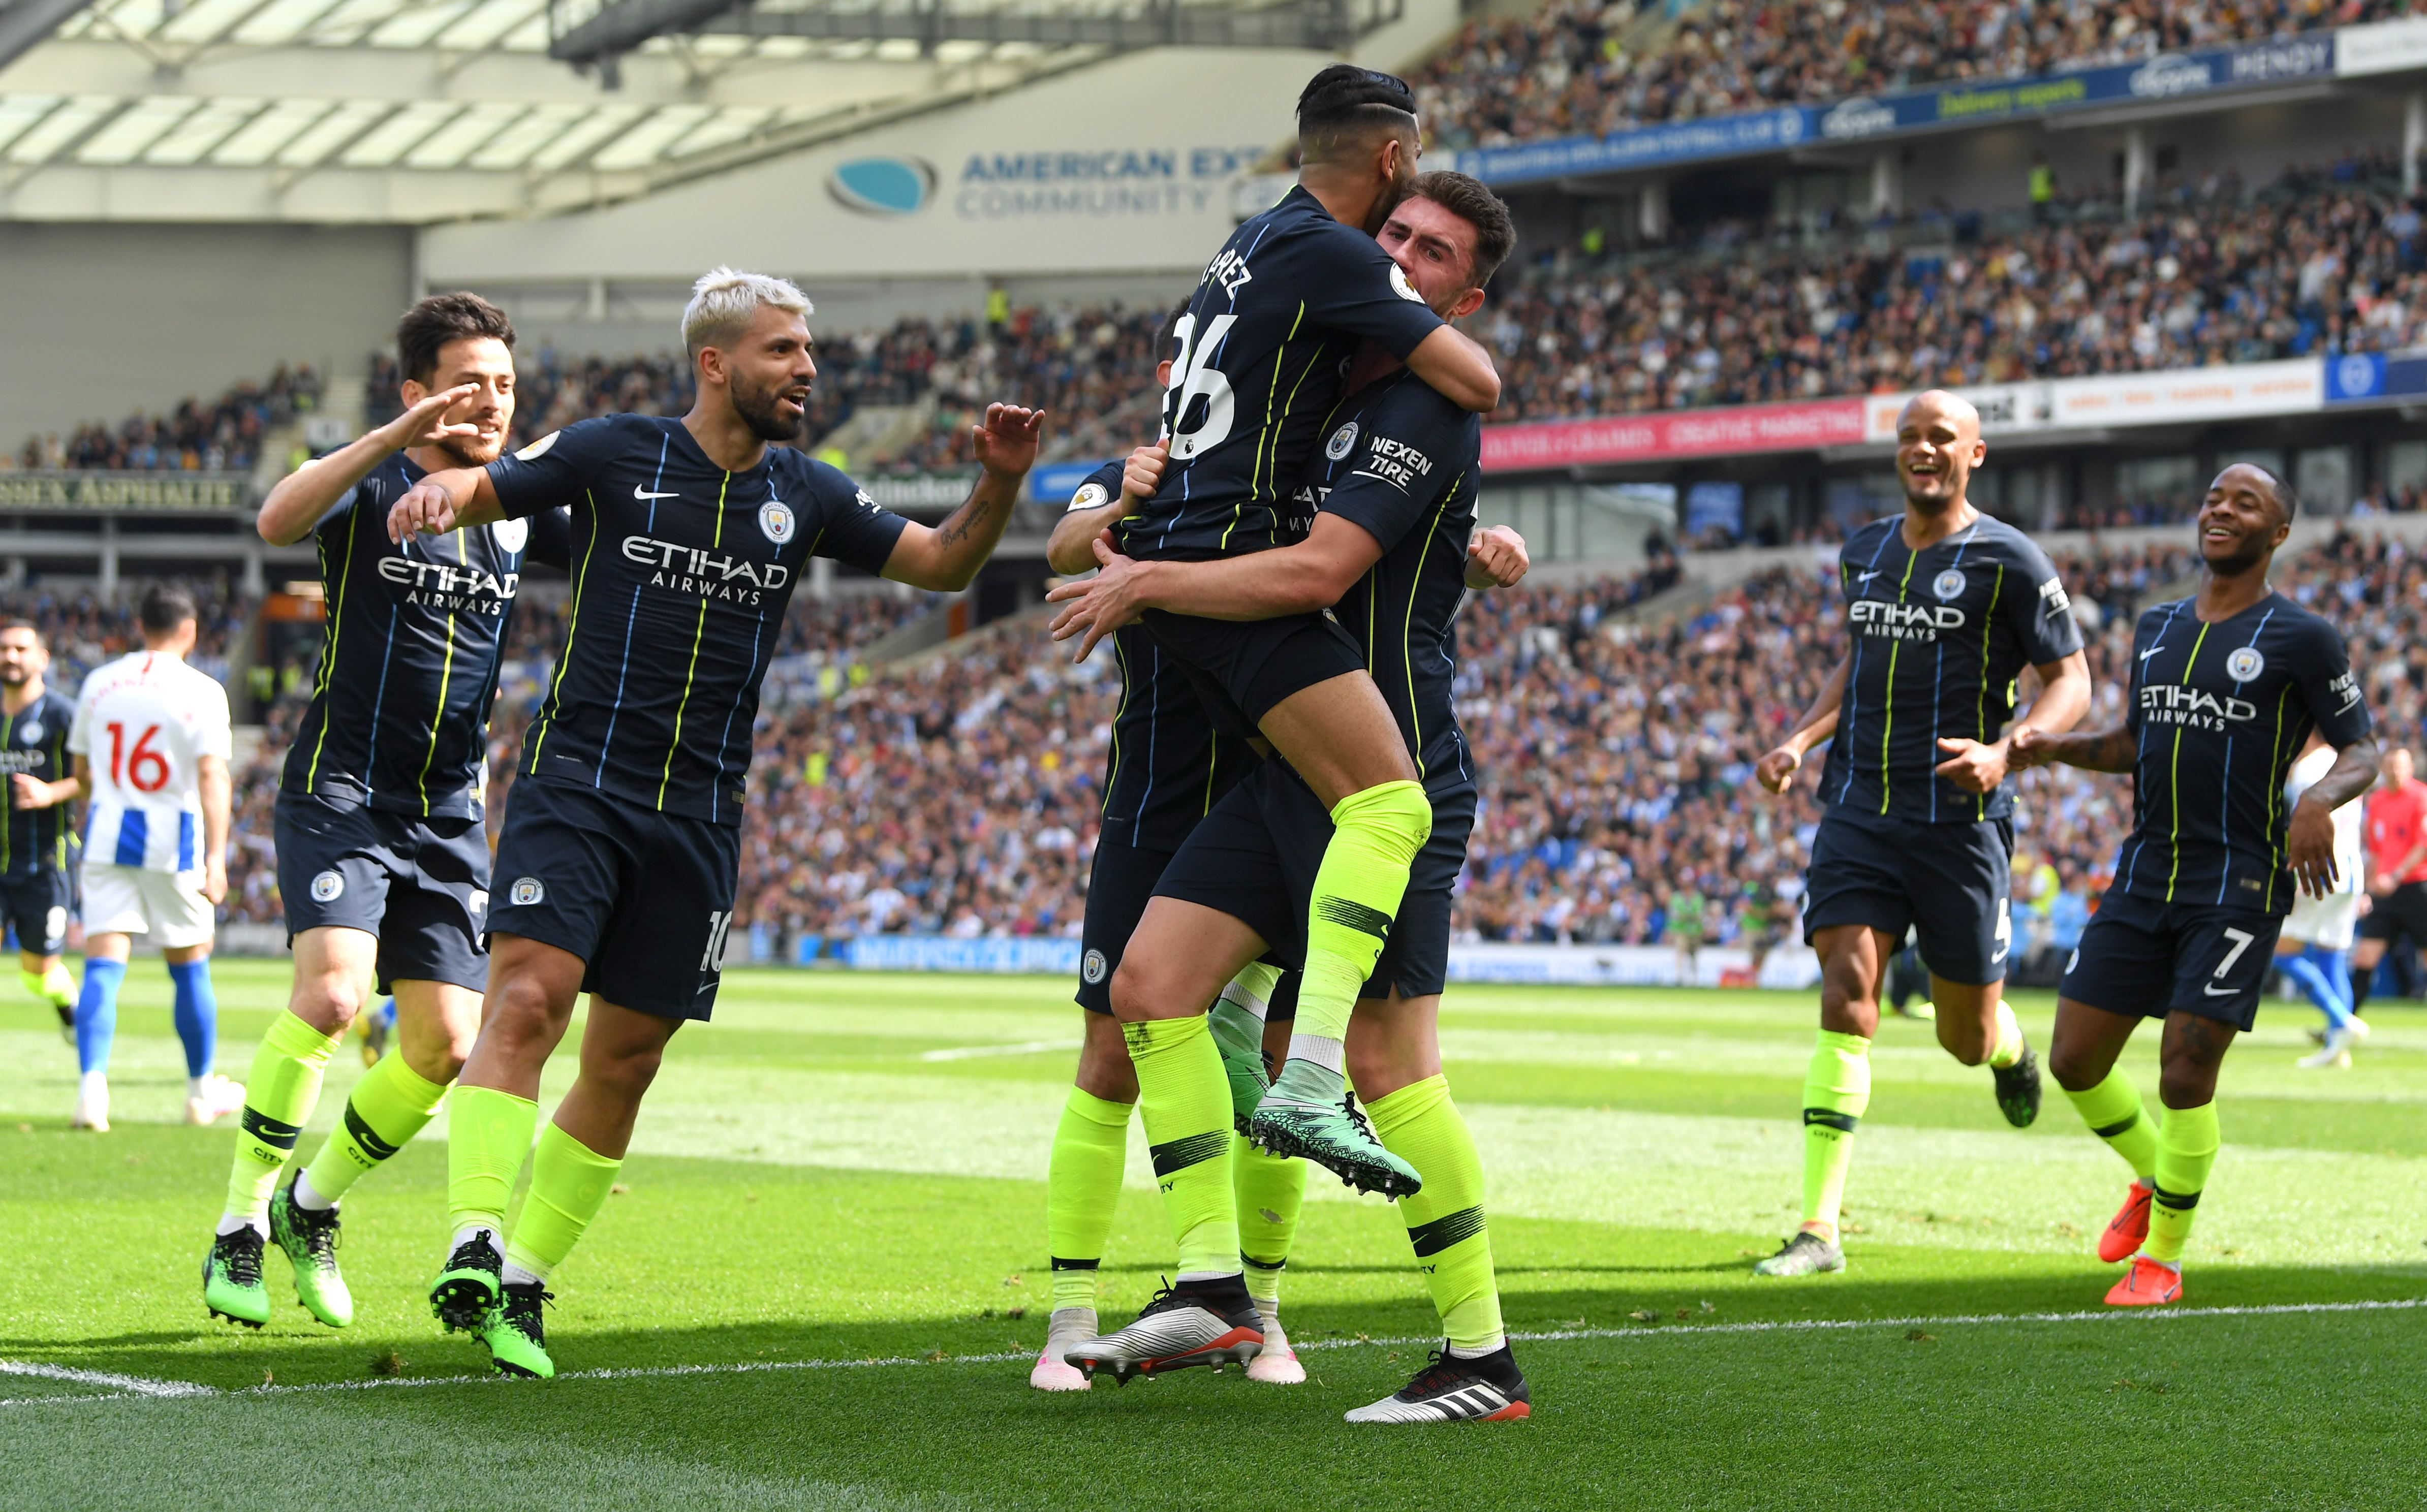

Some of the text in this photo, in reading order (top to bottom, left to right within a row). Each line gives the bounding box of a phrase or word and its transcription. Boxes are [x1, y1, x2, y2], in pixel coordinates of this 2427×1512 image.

[961, 149, 1174, 182] AMERICAN
[954, 182, 1218, 220] COMMUNITY
[1160, 312, 1239, 460] 26
[1370, 436, 1433, 477] NEXEN
[1370, 454, 1414, 487] TIRE
[378, 556, 519, 598] ETIHAD
[621, 536, 788, 589] ETIHAD
[406, 589, 503, 616] AIRWAYS
[650, 571, 761, 606] AIRWAYS
[1849, 600, 1966, 629] ETIHAD
[1863, 622, 1937, 643] AIRWAYS
[2140, 685, 2257, 721] ETIHAD
[2147, 709, 2226, 732] AIRWAYS
[107, 722, 169, 791] 16
[699, 910, 733, 972] 10
[2213, 927, 2255, 979] 7
[1813, 1129, 1840, 1142] CITY
[254, 1147, 285, 1163] CITY
[348, 1146, 376, 1169] CITY
